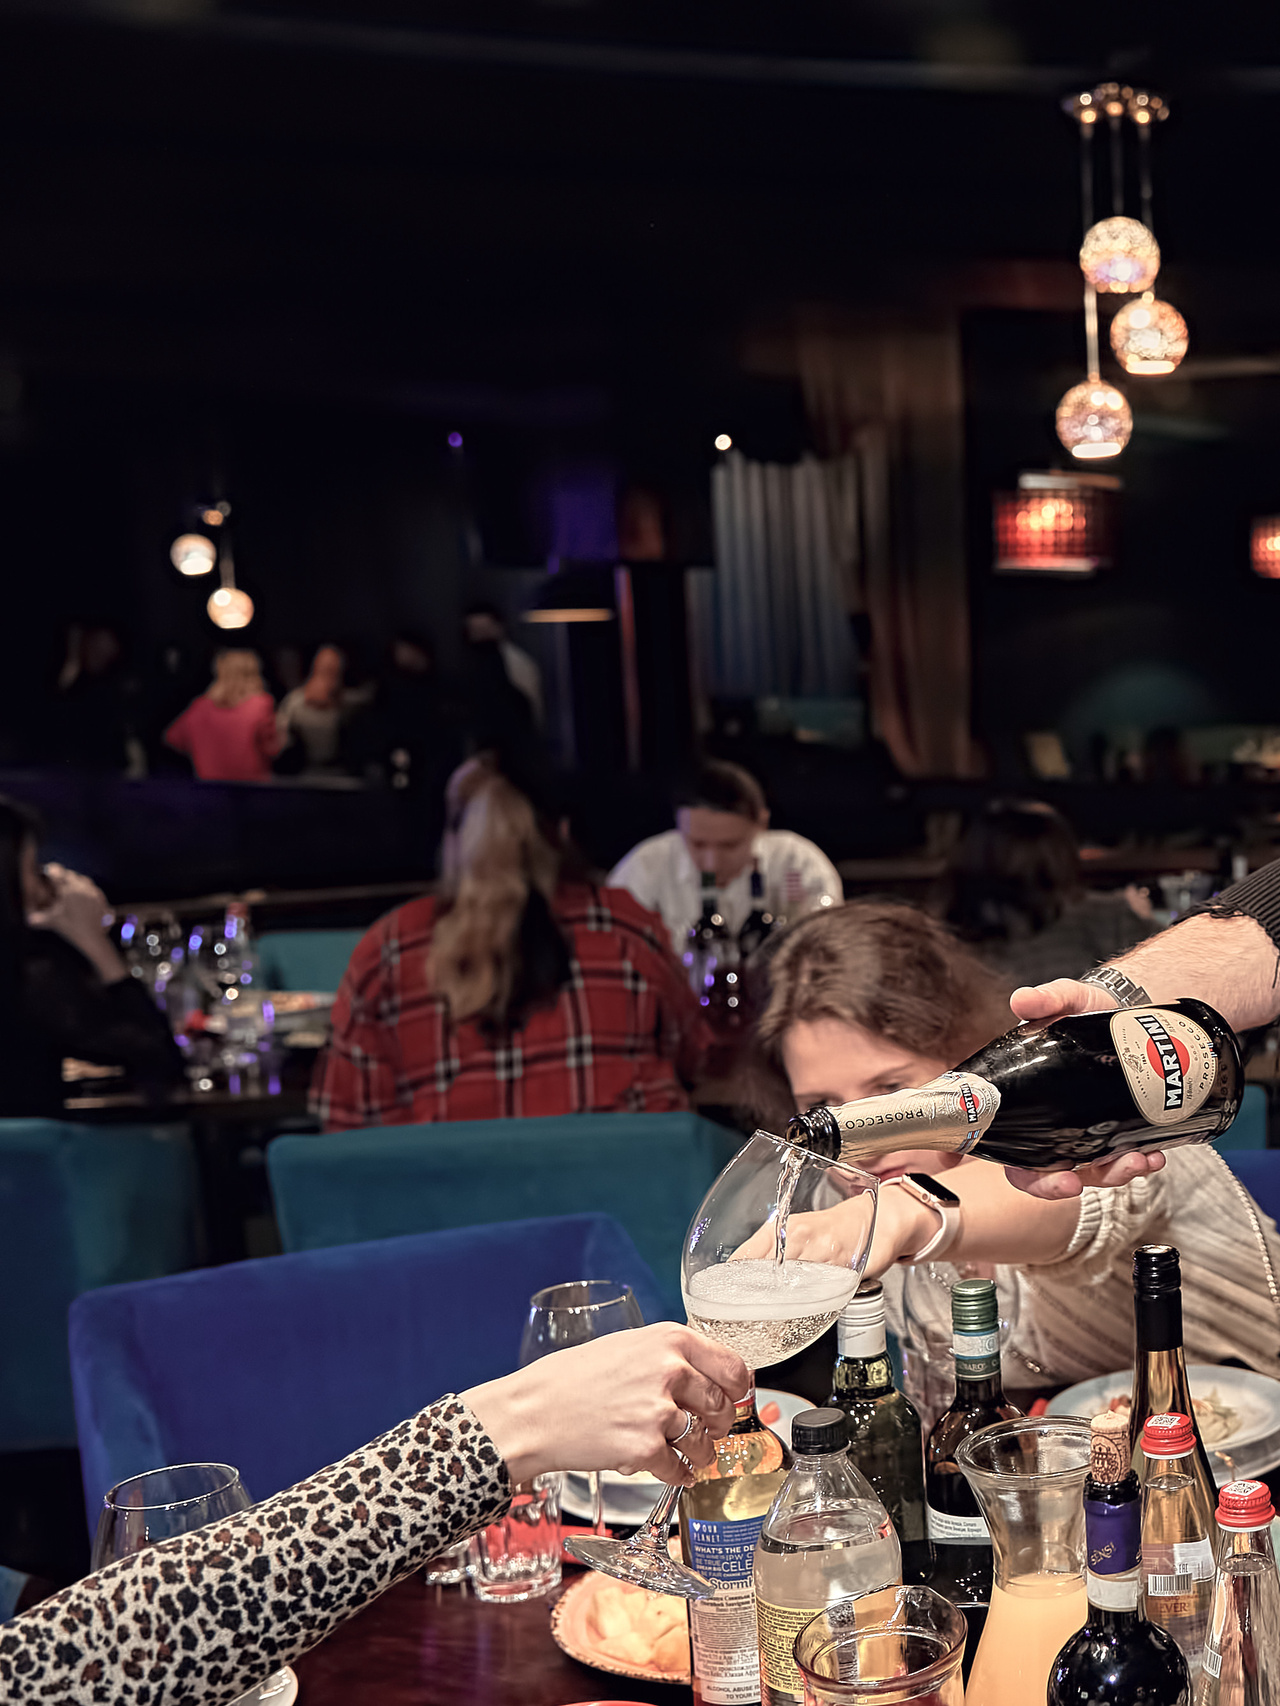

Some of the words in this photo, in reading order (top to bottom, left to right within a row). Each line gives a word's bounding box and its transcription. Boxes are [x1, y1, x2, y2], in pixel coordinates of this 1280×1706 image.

[1139, 1014, 1183, 1108] MARTINI
[1178, 1021, 1210, 1090] PROSECCO
[960, 1083, 978, 1123] MARTINI
[845, 1108, 924, 1130] PROSECCO
[693, 1533, 720, 1543] PLANET
[695, 1545, 723, 1554] WHAT'S
[725, 1546, 742, 1554] THE
